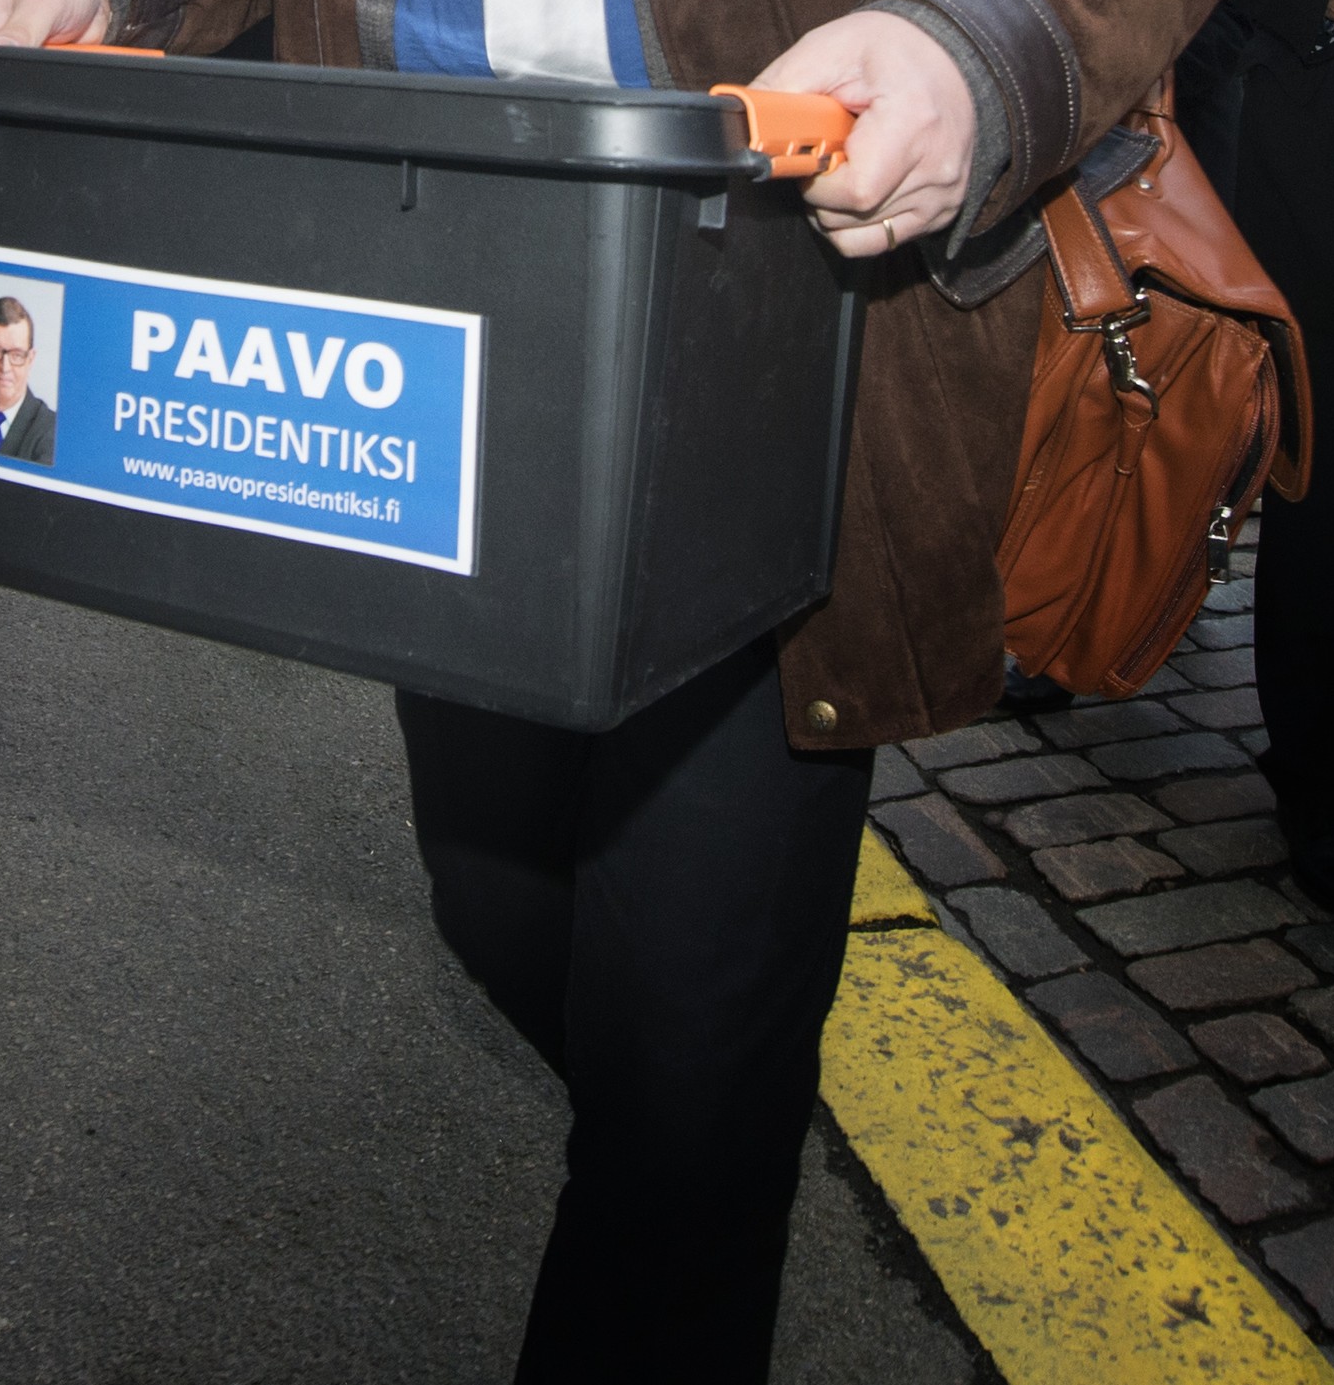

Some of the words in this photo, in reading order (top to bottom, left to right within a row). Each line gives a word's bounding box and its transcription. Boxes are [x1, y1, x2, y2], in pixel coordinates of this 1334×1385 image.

[131, 310, 404, 408] PAAVO
[114, 392, 416, 483] PRESIDENTIKSI
[123, 455, 401, 524] www.paavopresidentiksi.fi
